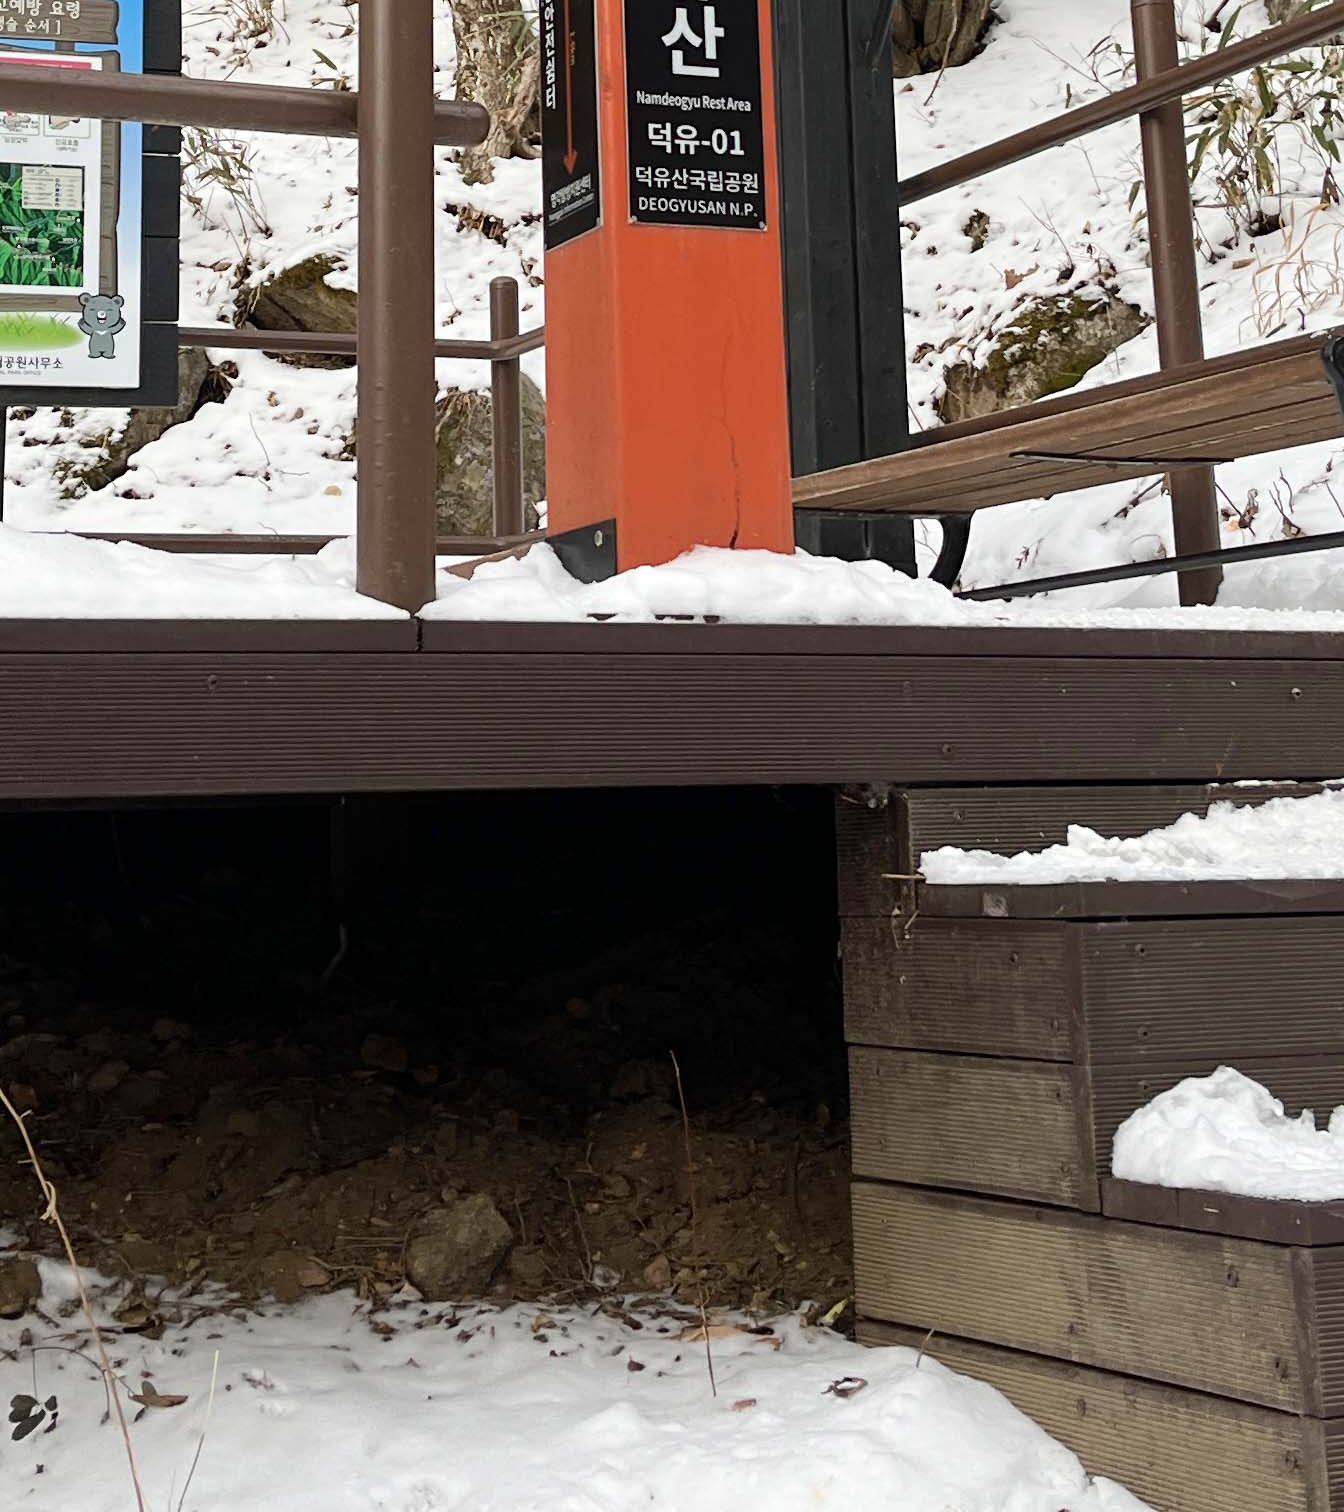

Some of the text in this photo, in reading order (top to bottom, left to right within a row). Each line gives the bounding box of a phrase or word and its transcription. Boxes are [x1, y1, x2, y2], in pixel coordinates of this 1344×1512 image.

[49, 1, 81, 19] 요령
[24, 18, 50, 34] 순서
[636, 90, 752, 112] Namdeogyu Rest Area
[647, 122, 745, 156] 덕유-01
[635, 166, 759, 194] 덕유산국립공원
[638, 196, 758, 217] DEOGYUSAN N.P.
